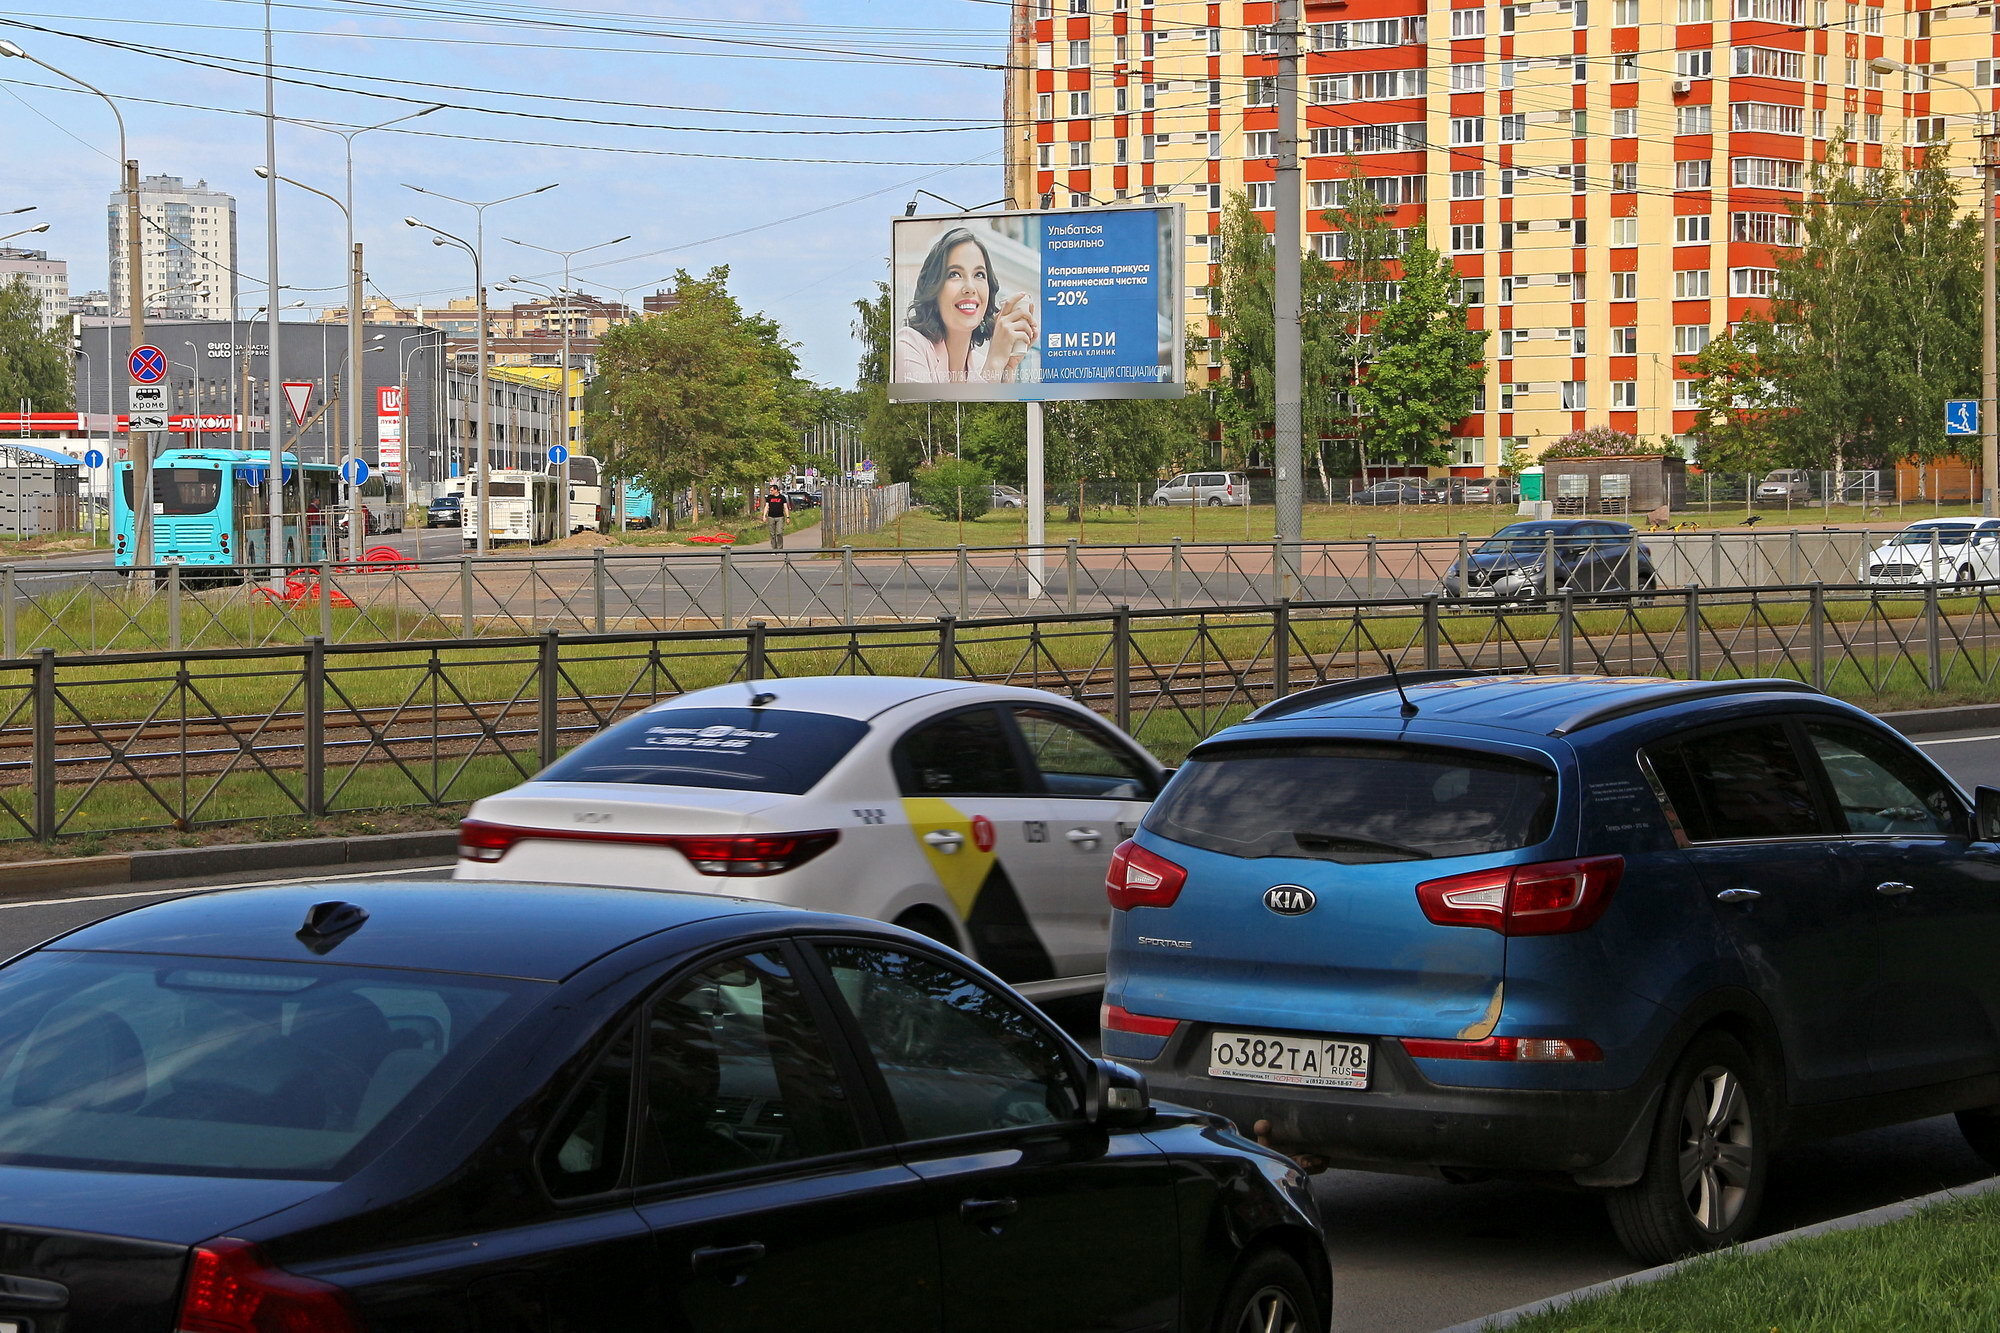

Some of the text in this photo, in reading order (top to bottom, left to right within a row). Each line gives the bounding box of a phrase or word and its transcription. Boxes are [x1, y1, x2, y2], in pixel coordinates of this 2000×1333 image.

[1047, 223, 1103, 236] Улыбаться
[1048, 238, 1105, 251] правильно
[1047, 263, 1150, 277] Исправление прикуса
[1047, 275, 1148, 288] Гигиеническая чистка
[207, 342, 231, 350] euro
[207, 350, 231, 358] auto
[1047, 348, 1116, 358] СИСТЕМА КЛИНИК
[1011, 367, 1059, 382] НЕОБХОДИМА
[1060, 366, 1115, 380] КОНСУЛЬТАЦИЯ
[1116, 364, 1168, 380] СПЕЦИАЛИСТА
[132, 402, 165, 410] кроме
[180, 415, 233, 429] ЛУКОЙЛ
[1270, 890, 1307, 909] KIA
[1138, 936, 1192, 949] SPORTAGE
[1324, 1043, 1363, 1068] 178
[1331, 1066, 1351, 1076] RUS
